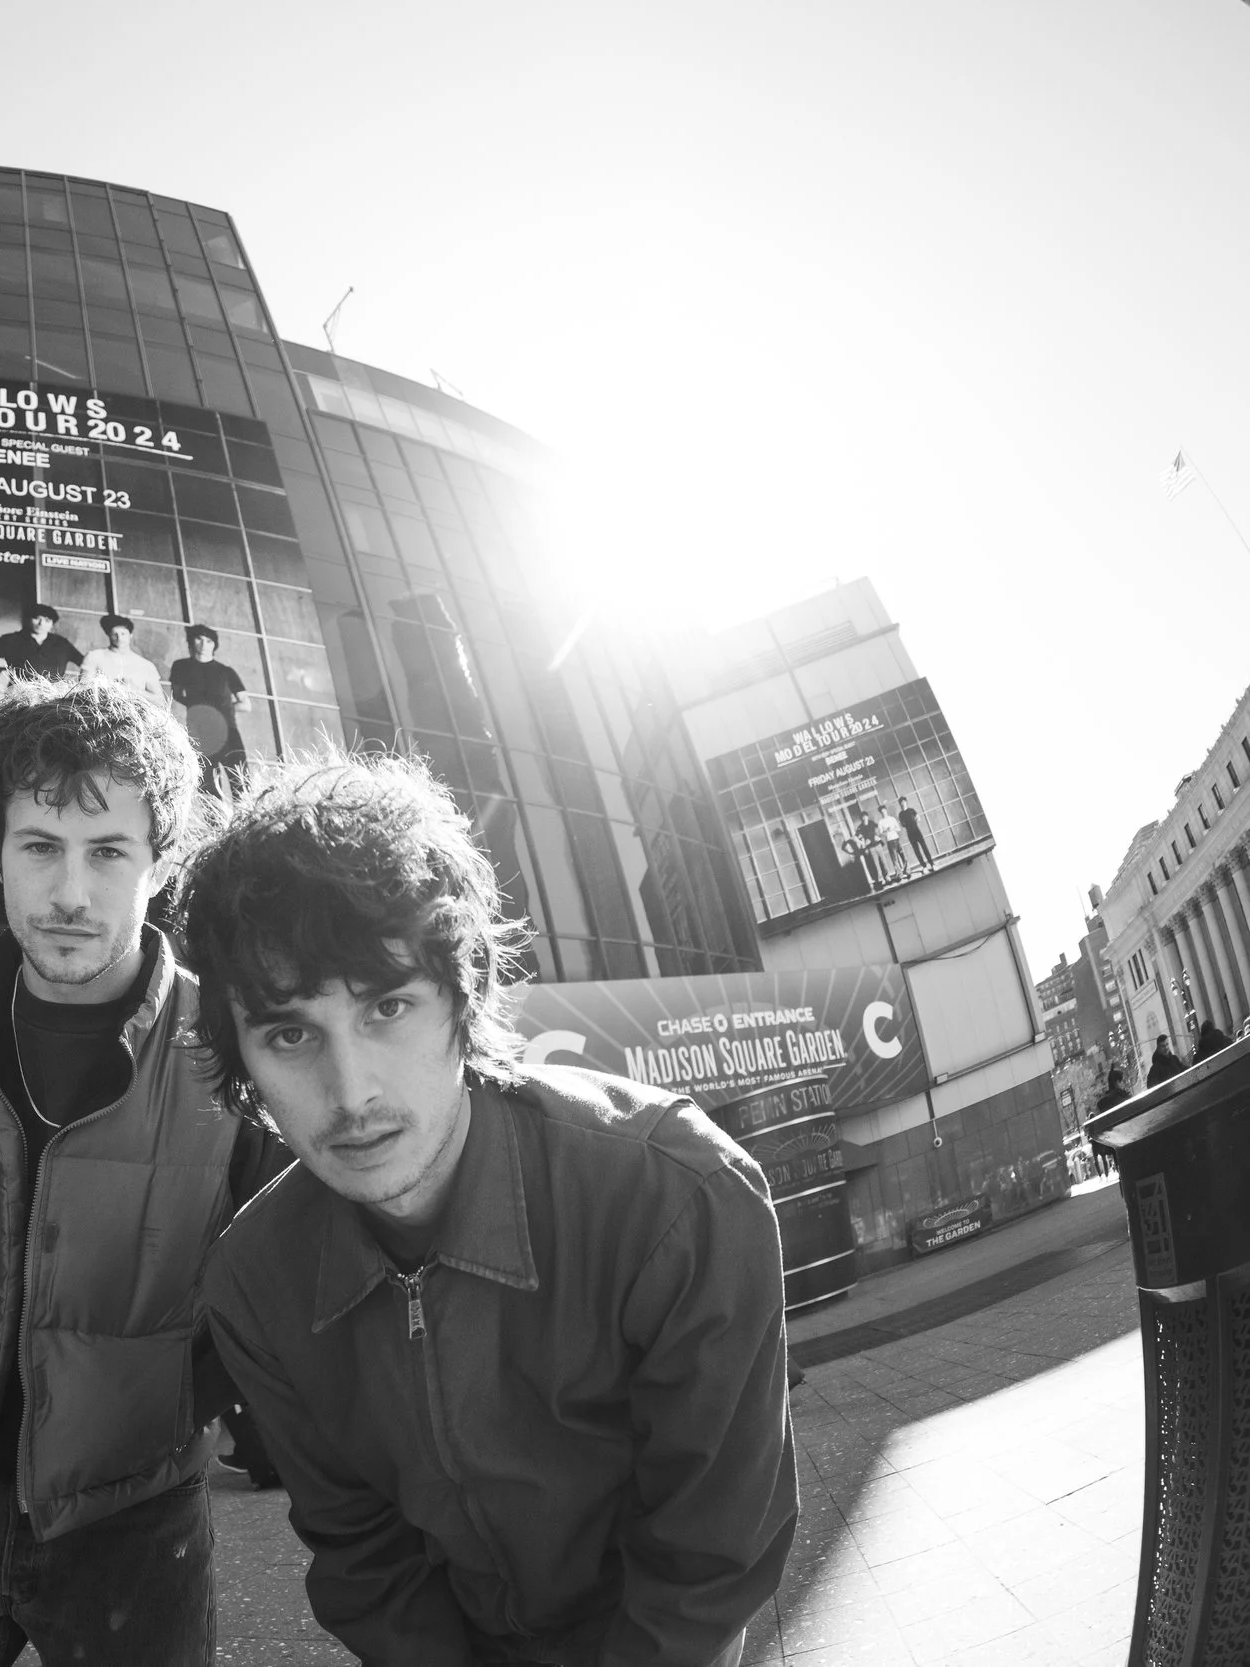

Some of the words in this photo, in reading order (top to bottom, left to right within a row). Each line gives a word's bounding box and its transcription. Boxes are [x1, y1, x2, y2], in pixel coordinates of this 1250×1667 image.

[1, 438, 49, 451] SPECIAL
[51, 443, 90, 456] GUEST
[86, 419, 181, 451] 2024
[103, 489, 131, 509] 23
[26, 506, 79, 521] Einstein
[52, 530, 118, 551] GARDEN
[792, 713, 854, 745] WALLOWS
[849, 714, 879, 735] 2024
[808, 770, 835, 788] FRIDAY
[836, 759, 865, 778] AUGUST
[657, 1016, 713, 1036] CHASE
[732, 1007, 815, 1029] ENTRANCE
[863, 1001, 902, 1059] C
[624, 1043, 718, 1085] MADISON
[719, 1036, 787, 1077] SQUARE
[785, 1029, 845, 1066] GARDEN
[693, 1080, 736, 1092] WORLD'S
[738, 1076, 761, 1087] MOST
[763, 1071, 796, 1083] FAMOUS
[798, 1067, 823, 1077] ARENA
[926, 1235, 944, 1247] THE
[945, 1220, 981, 1240] GARDEN
[936, 1221, 962, 1235] WELCOME
